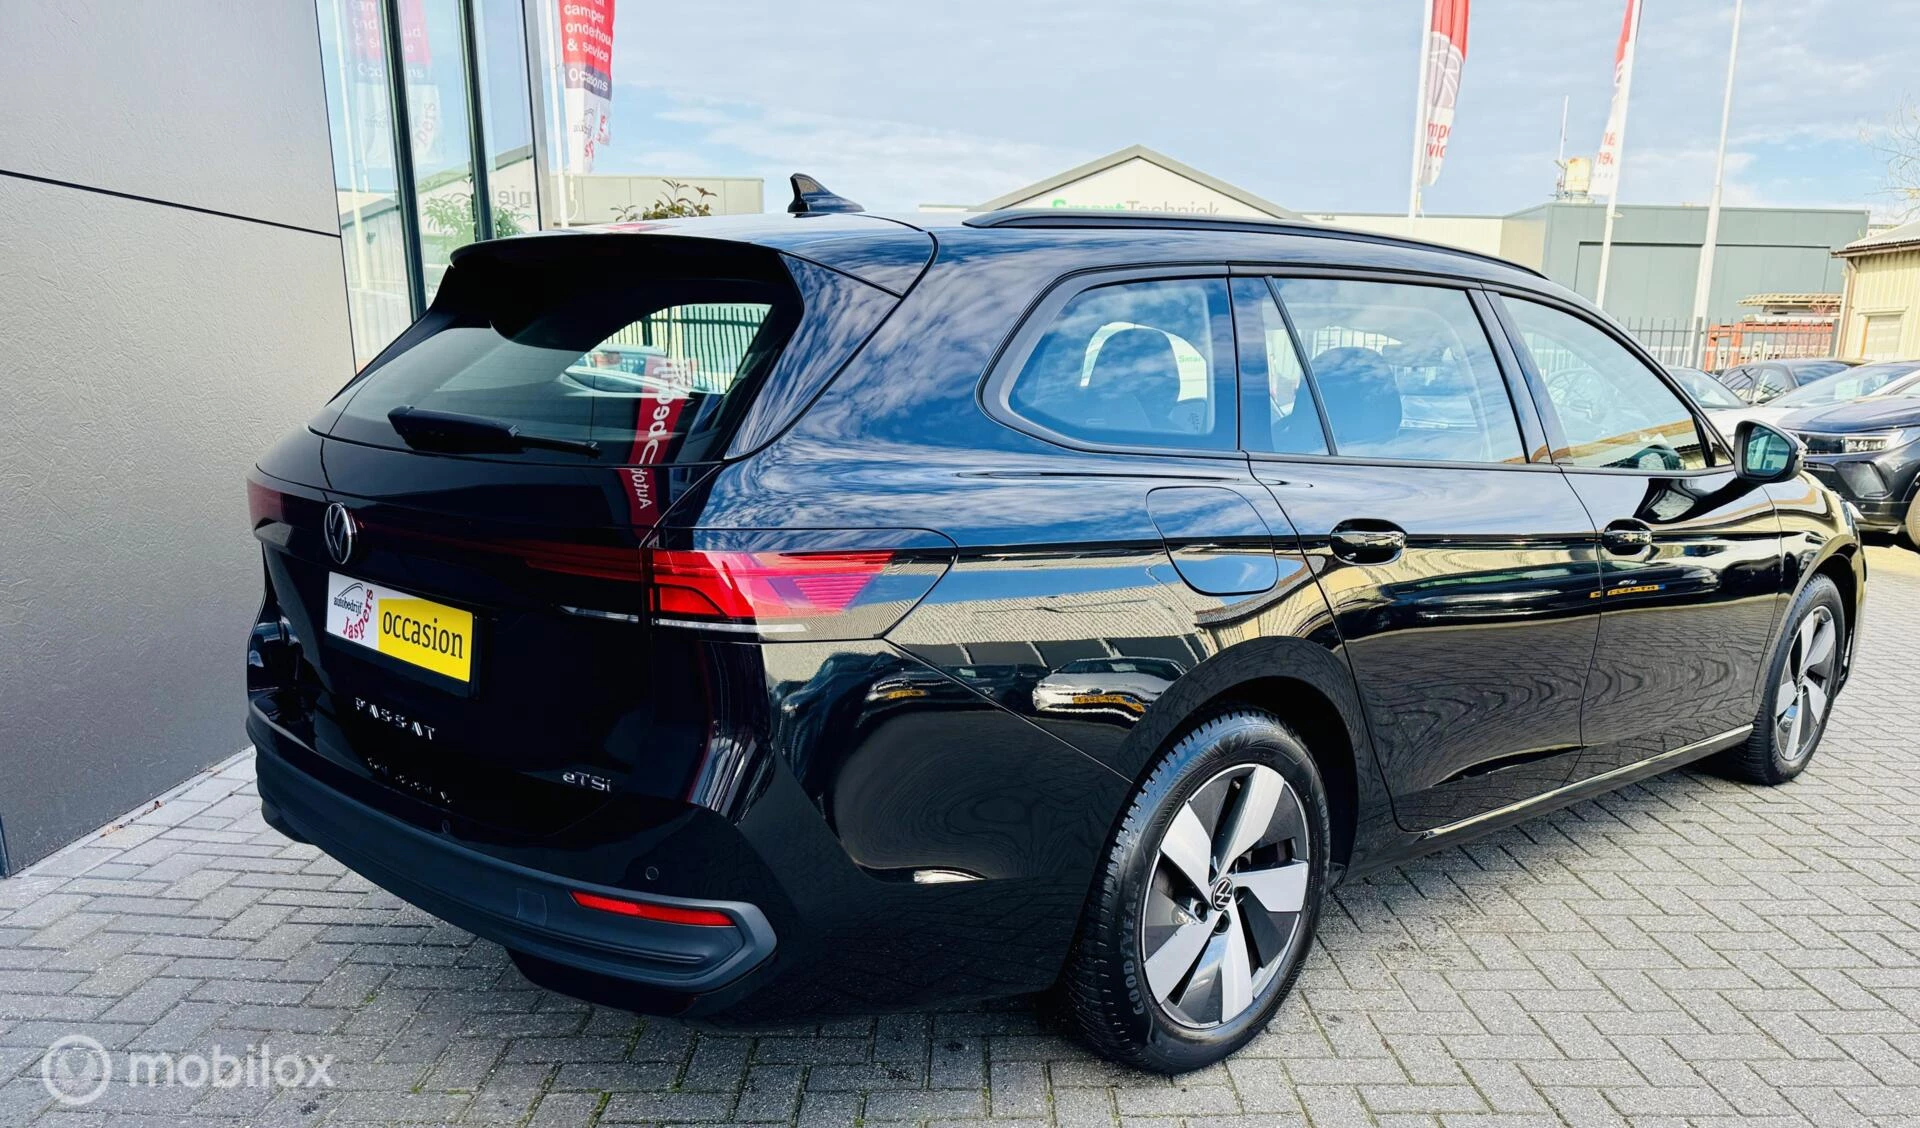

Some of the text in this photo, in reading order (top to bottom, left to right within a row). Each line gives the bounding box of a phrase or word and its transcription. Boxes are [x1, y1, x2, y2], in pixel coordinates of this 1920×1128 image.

[564, 4, 605, 24] camper
[567, 38, 578, 52] &
[333, 596, 363, 617] autobedrijf
[343, 588, 374, 640] Jaspers
[382, 611, 463, 660] occasion
[355, 697, 437, 740] PASSAT
[562, 771, 611, 792] eTSi
